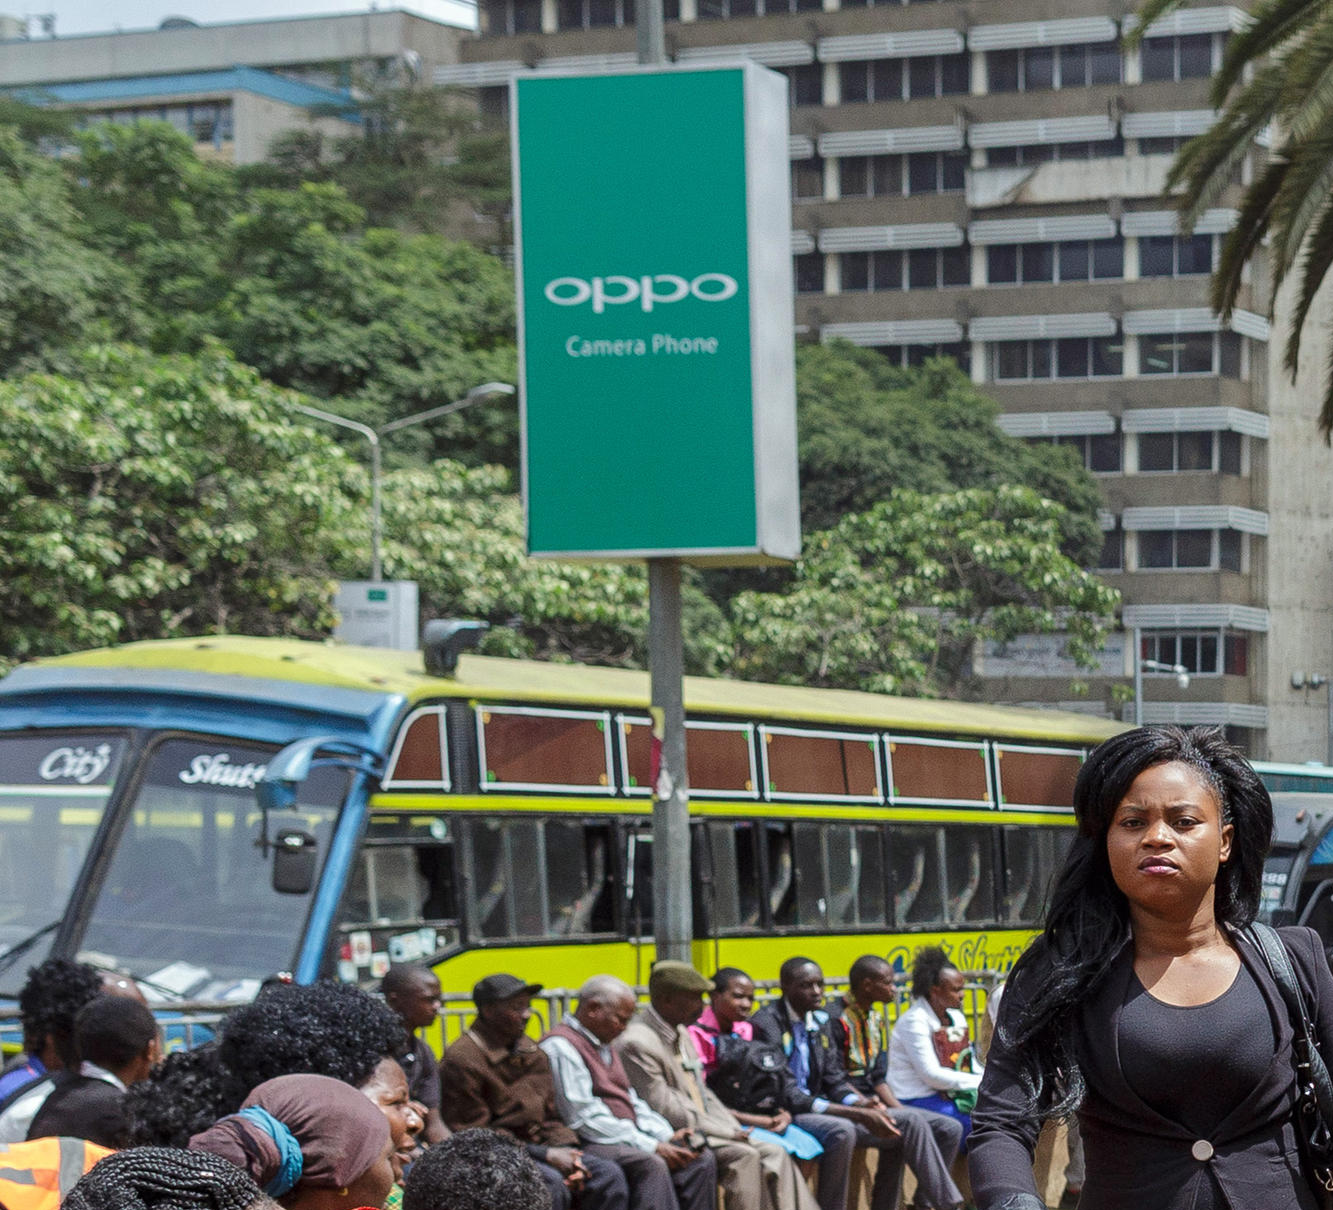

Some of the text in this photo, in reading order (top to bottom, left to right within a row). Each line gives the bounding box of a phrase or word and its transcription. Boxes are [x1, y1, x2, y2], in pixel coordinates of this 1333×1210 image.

[544, 272, 739, 314] oppo
[565, 333, 719, 358] Camera Phone
[39, 743, 112, 784] City
